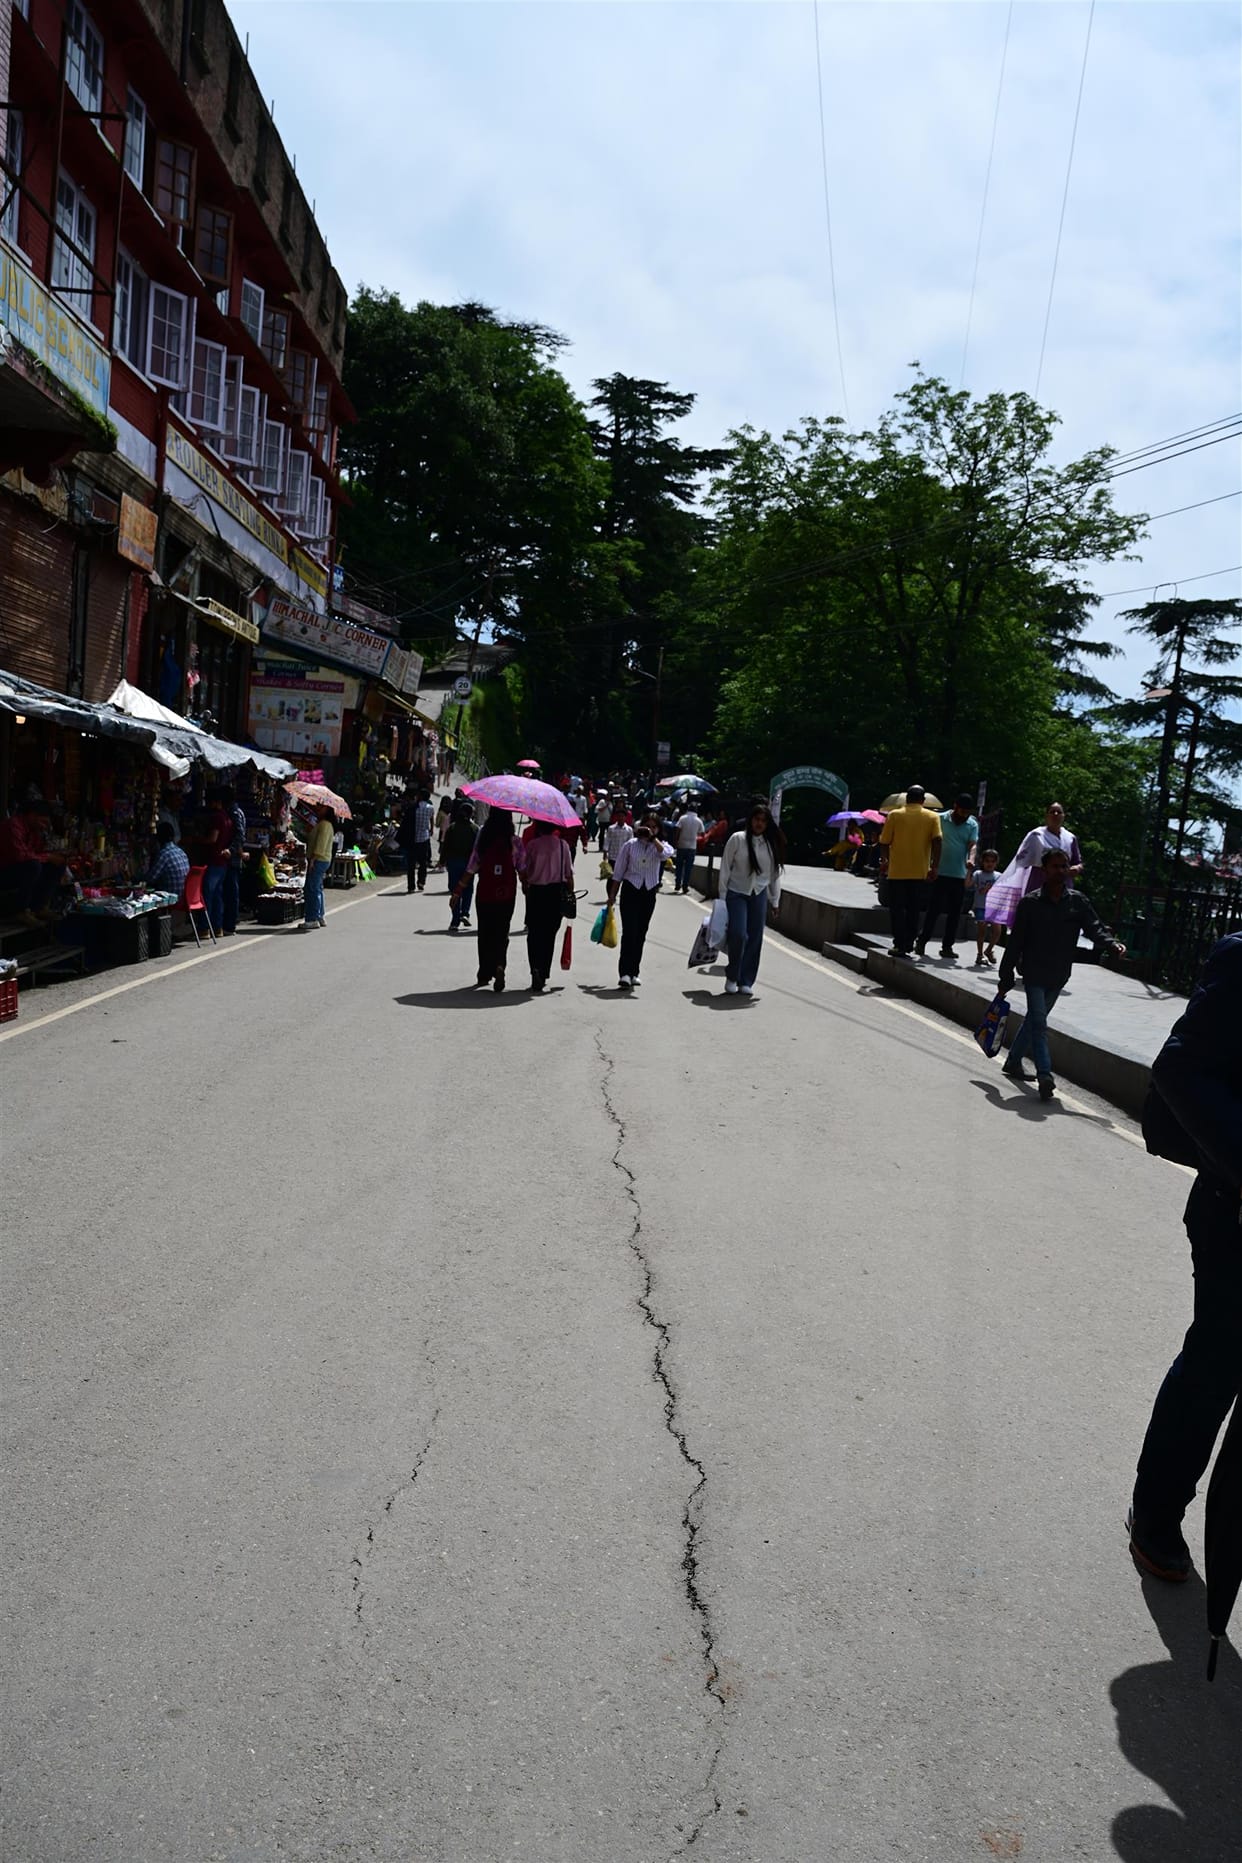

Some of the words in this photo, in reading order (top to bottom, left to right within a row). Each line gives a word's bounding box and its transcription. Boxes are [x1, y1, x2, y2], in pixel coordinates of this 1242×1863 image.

[47, 306, 99, 390] SCHOOL
[174, 431, 220, 497] ROLLER
[222, 479, 261, 536] SKATING
[272, 600, 321, 628] HIMACHAL
[345, 627, 388, 652] CORNER
[458, 681, 469, 689] 20
